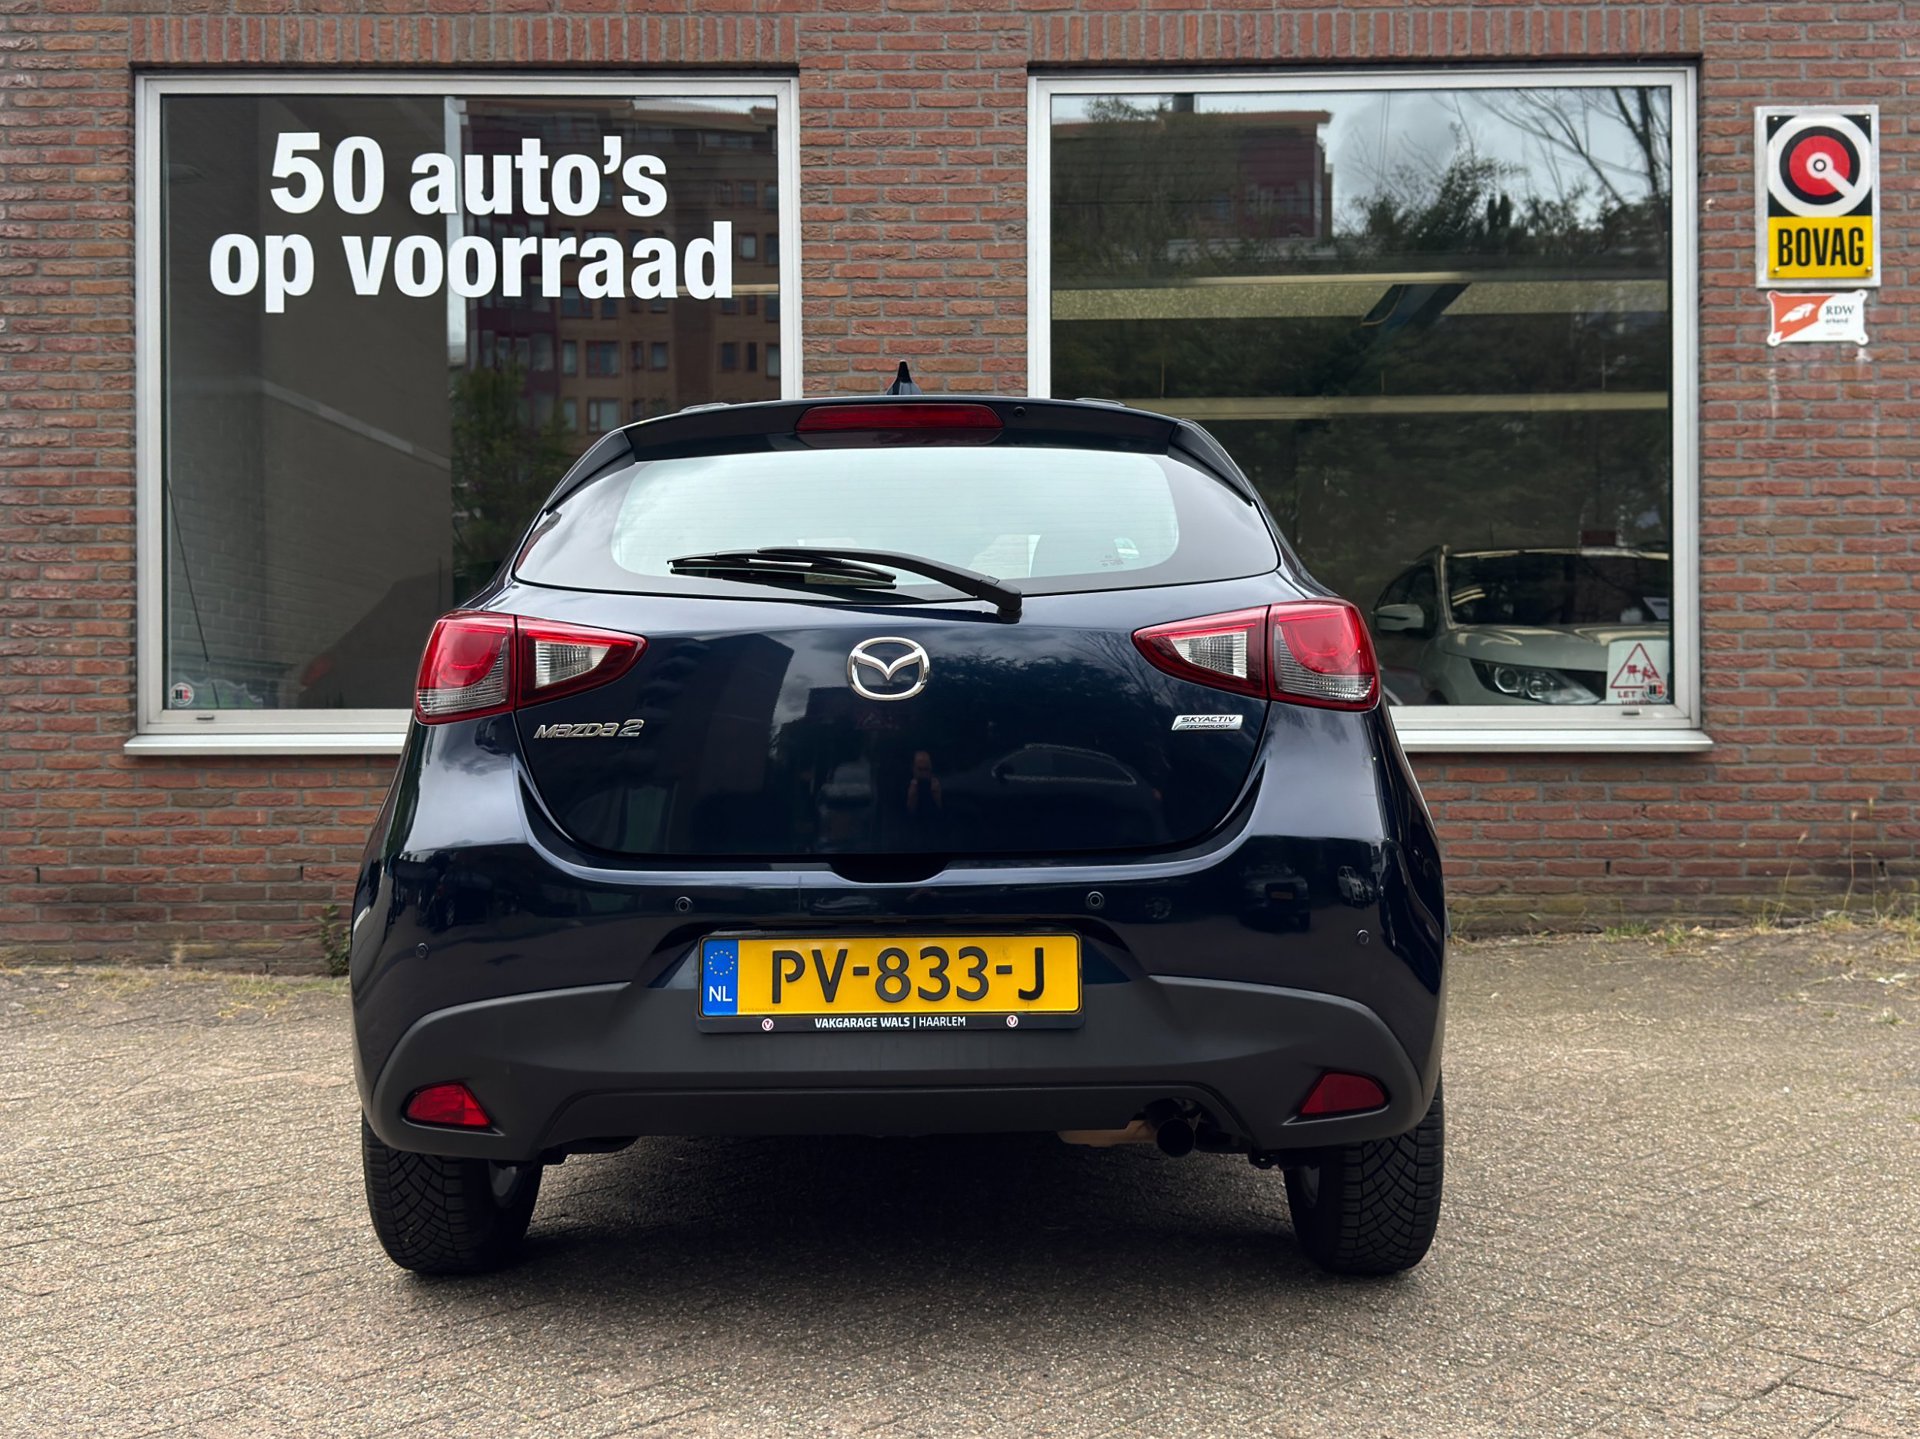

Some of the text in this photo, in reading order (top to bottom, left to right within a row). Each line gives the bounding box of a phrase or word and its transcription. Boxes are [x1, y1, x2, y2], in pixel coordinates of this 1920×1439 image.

[270, 132, 668, 217] 50 auto's
[1777, 227, 1864, 267] BOVAG
[209, 221, 733, 313] op voorraad
[1826, 305, 1855, 315] RDW
[1617, 690, 1637, 698] LET
[617, 719, 645, 737] 2
[771, 946, 1045, 1004] PV-833-J
[709, 986, 732, 1002] NL
[815, 1018, 877, 1028] VAKGARAGE
[880, 1017, 910, 1028] WALS
[919, 1016, 966, 1027] HAARLEM
